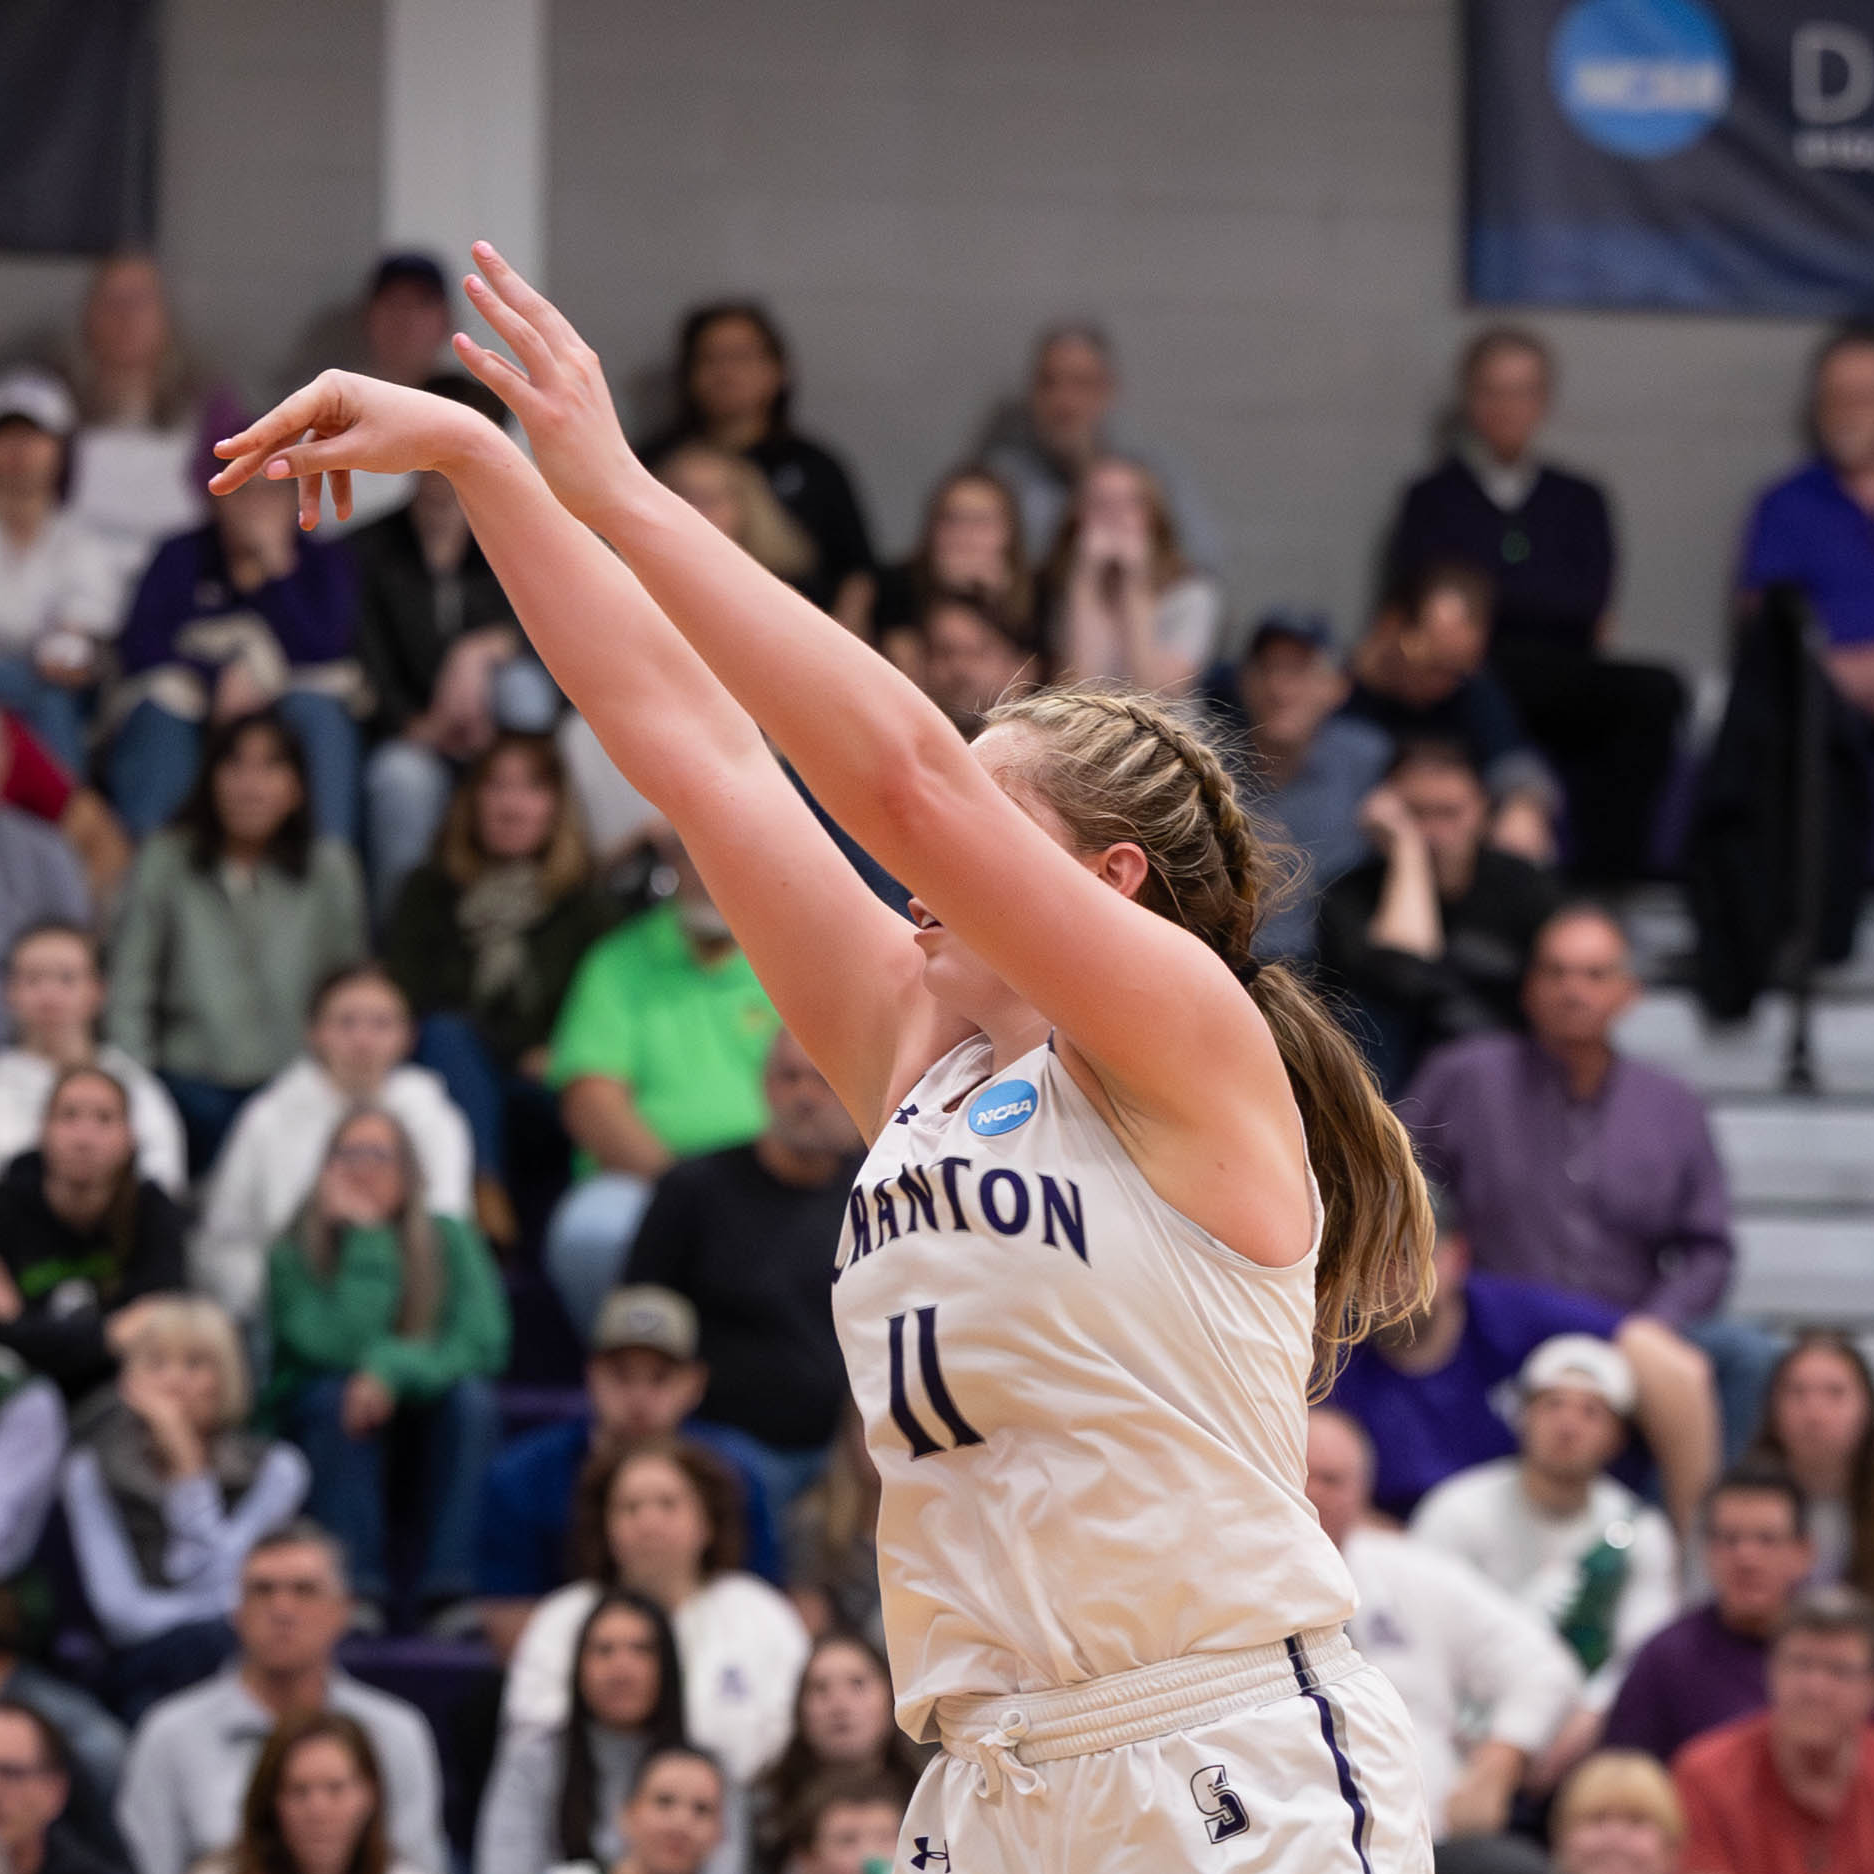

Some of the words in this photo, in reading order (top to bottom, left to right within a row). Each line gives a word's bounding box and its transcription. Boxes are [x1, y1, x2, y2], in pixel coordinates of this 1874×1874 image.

[975, 1098, 1034, 1127] NCAA
[831, 1156, 1093, 1285] RANTON
[884, 1303, 988, 1462] 11
[1189, 1764, 1250, 1844] S
